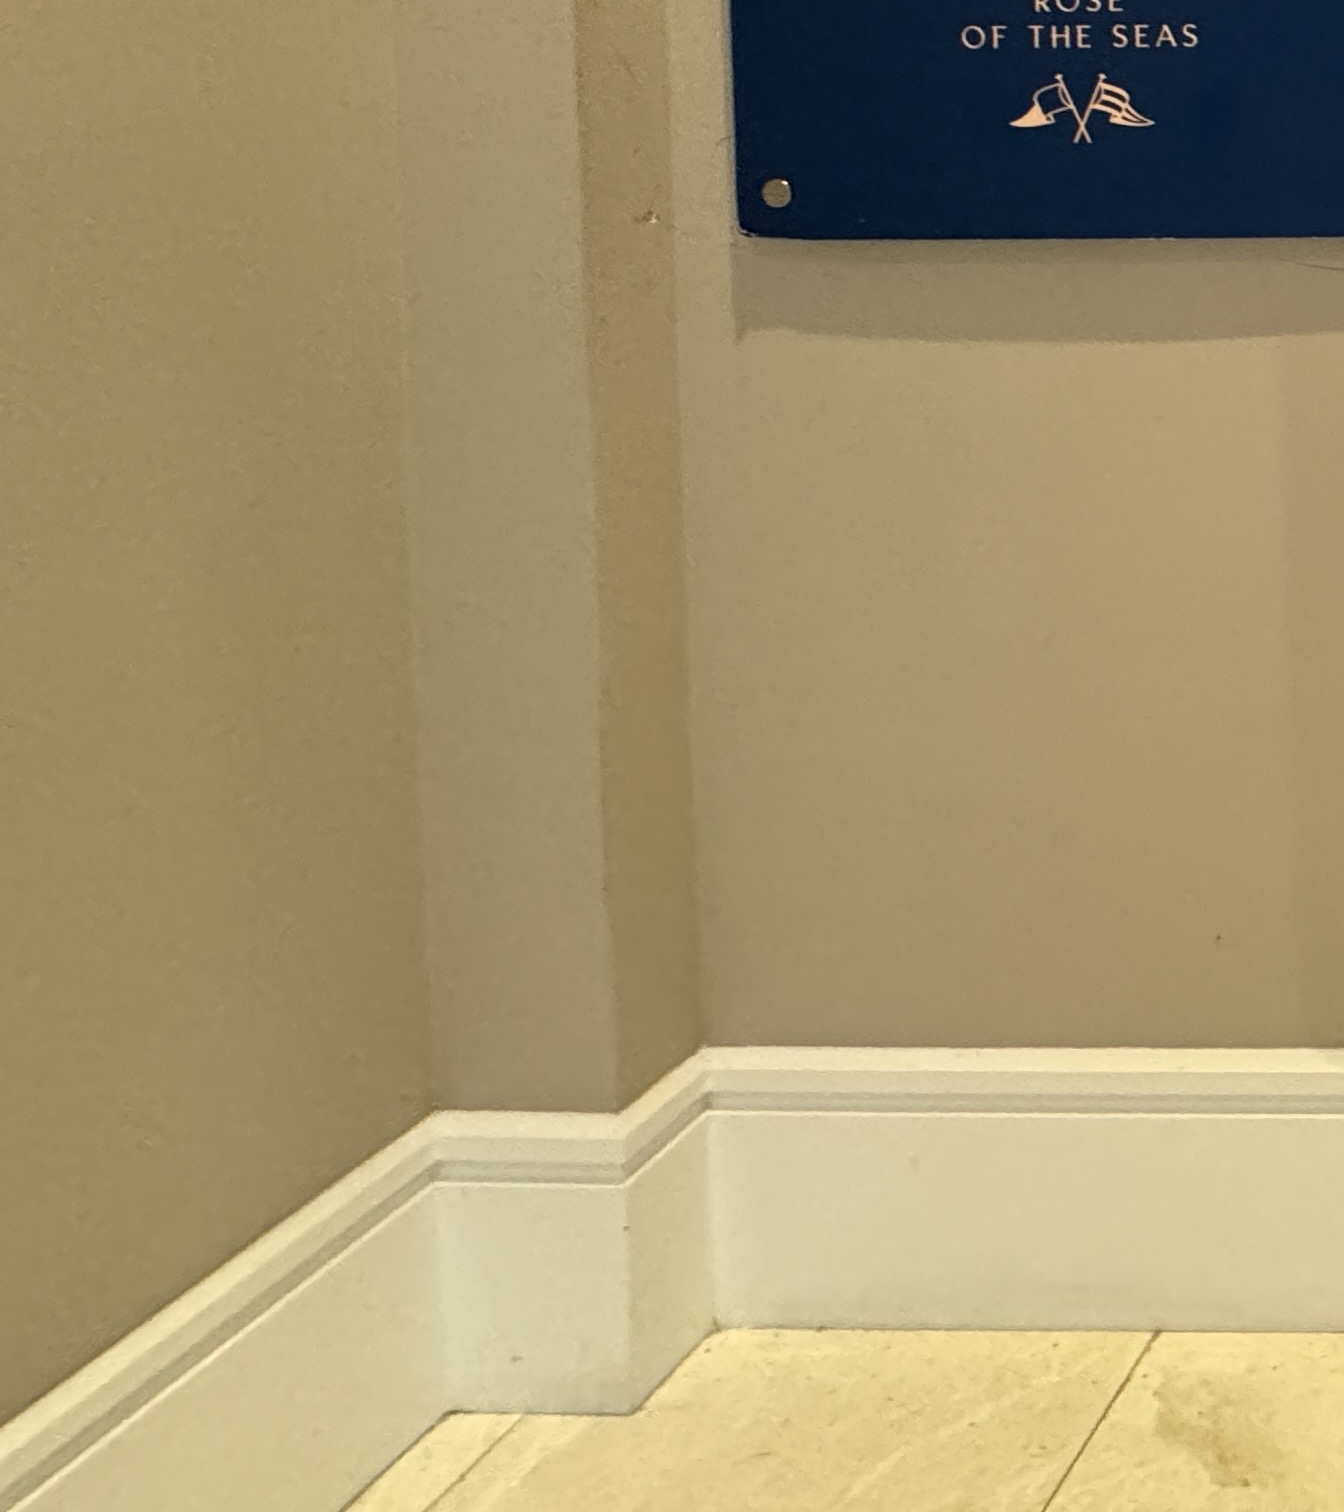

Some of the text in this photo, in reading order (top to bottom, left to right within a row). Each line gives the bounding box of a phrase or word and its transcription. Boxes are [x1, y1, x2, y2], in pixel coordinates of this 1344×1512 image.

[961, 23, 1199, 49] OF THE SEAS
